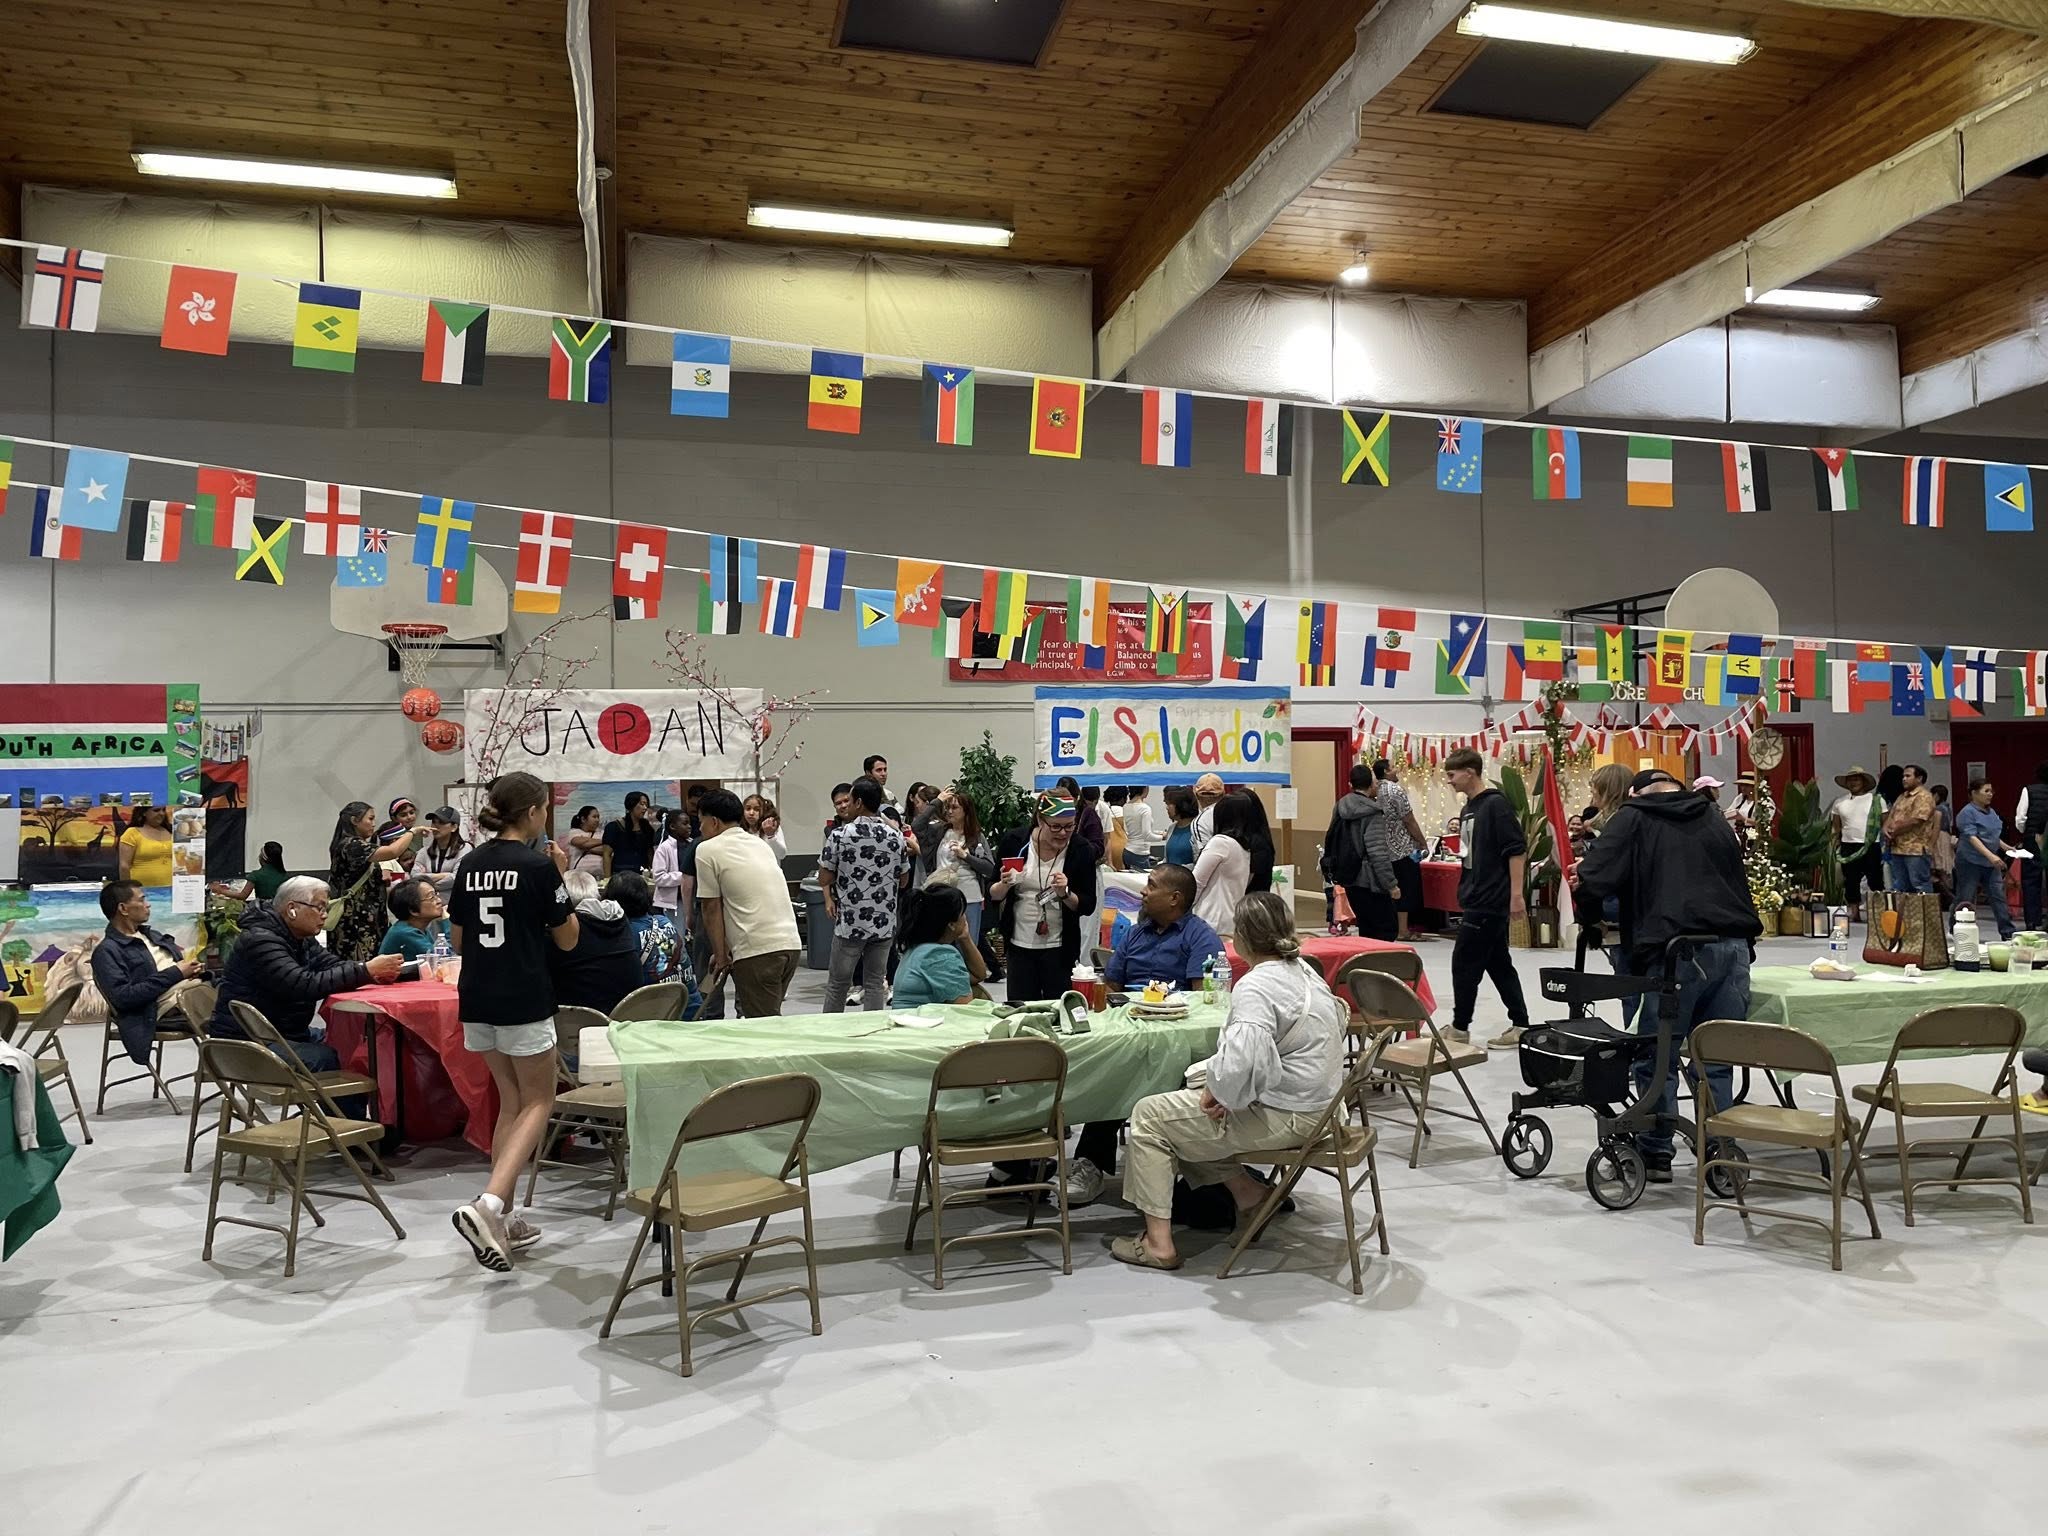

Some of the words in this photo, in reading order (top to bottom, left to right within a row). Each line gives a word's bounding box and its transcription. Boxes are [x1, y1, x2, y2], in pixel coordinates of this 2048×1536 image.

[1043, 640, 1060, 649] fear
[1048, 651, 1066, 659] true
[1117, 651, 1153, 660] Balanced
[1114, 661, 1136, 670] climb
[1139, 662, 1148, 670] to
[520, 701, 726, 757] JAPAN
[1051, 706, 1099, 767] El
[1104, 706, 1284, 769] Salvador
[71, 735, 165, 756] AFRICA
[465, 870, 519, 892] LLOYD
[479, 896, 505, 948] 5
[1546, 979, 1567, 993] drive
